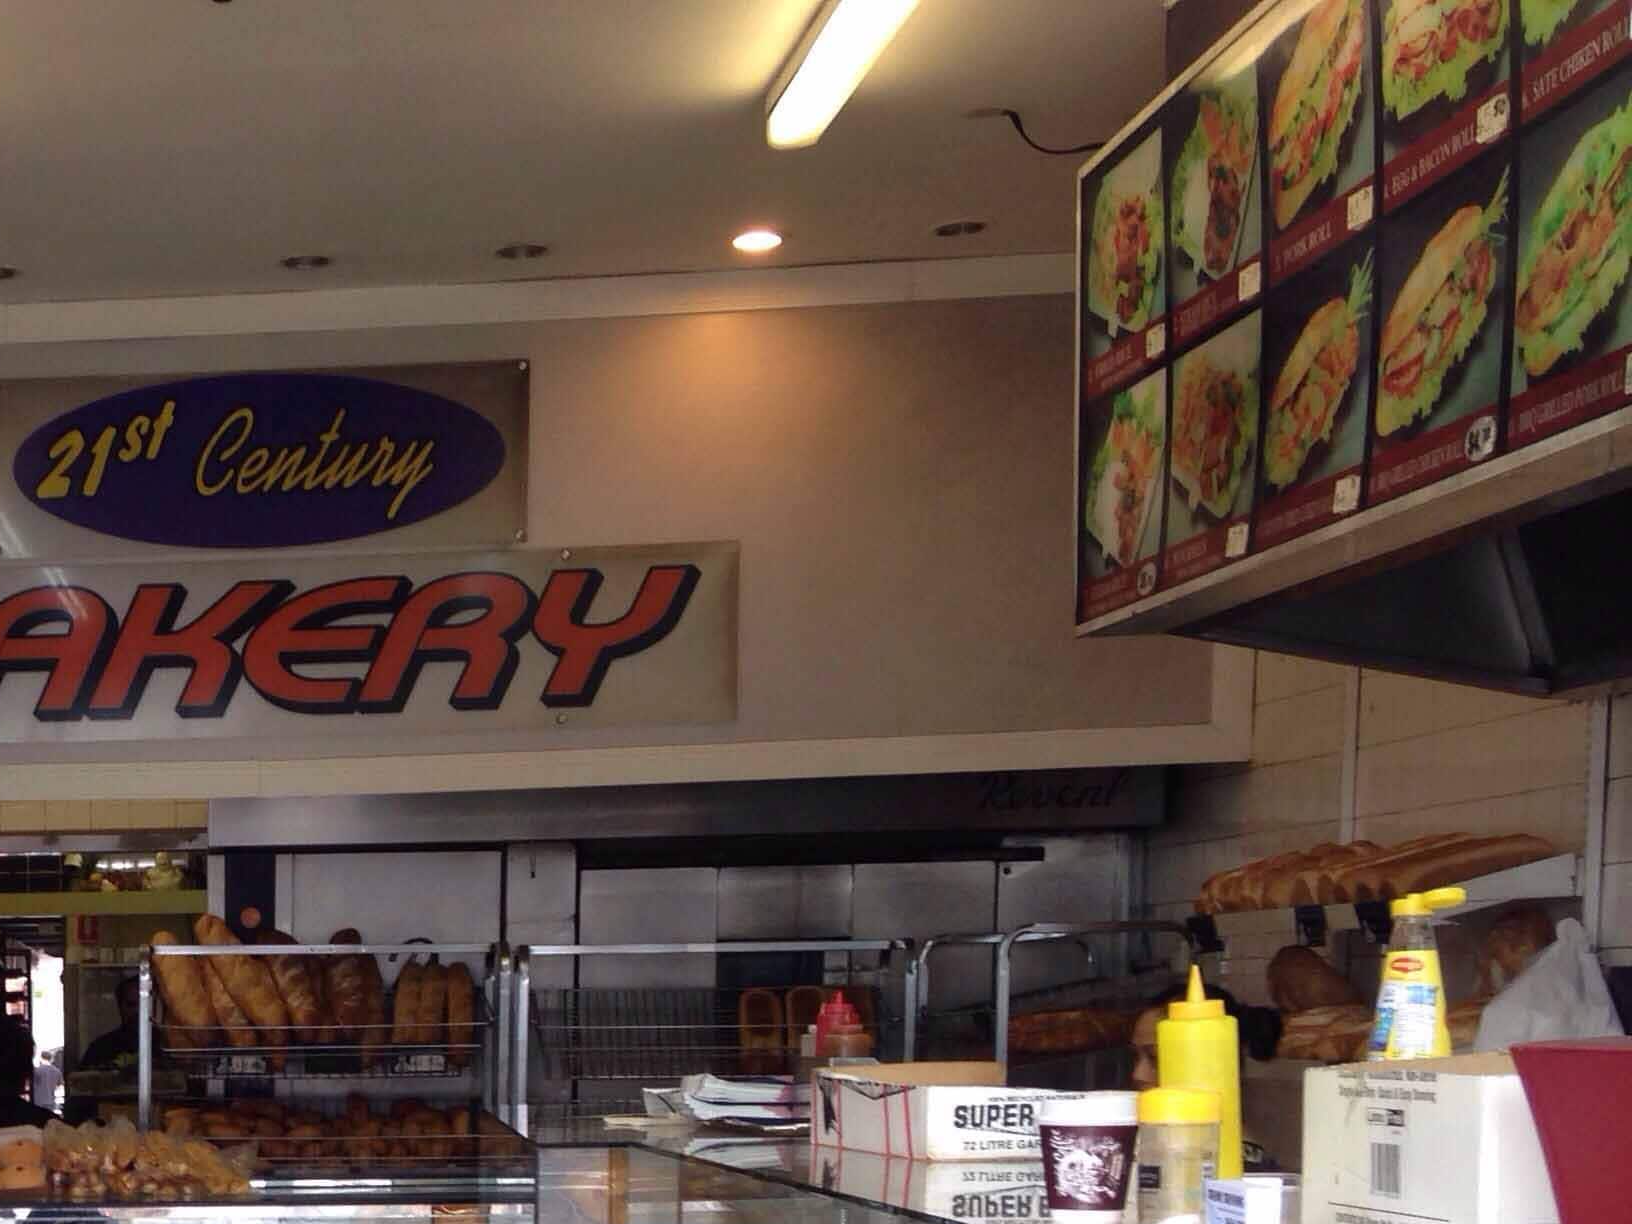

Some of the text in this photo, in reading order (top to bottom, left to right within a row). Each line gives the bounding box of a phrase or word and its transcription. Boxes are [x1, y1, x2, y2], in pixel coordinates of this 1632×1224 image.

[36, 400, 434, 521] 21st Century
[953, 1102, 1035, 1129] SUPER
[979, 1139, 1013, 1151] LITRE
